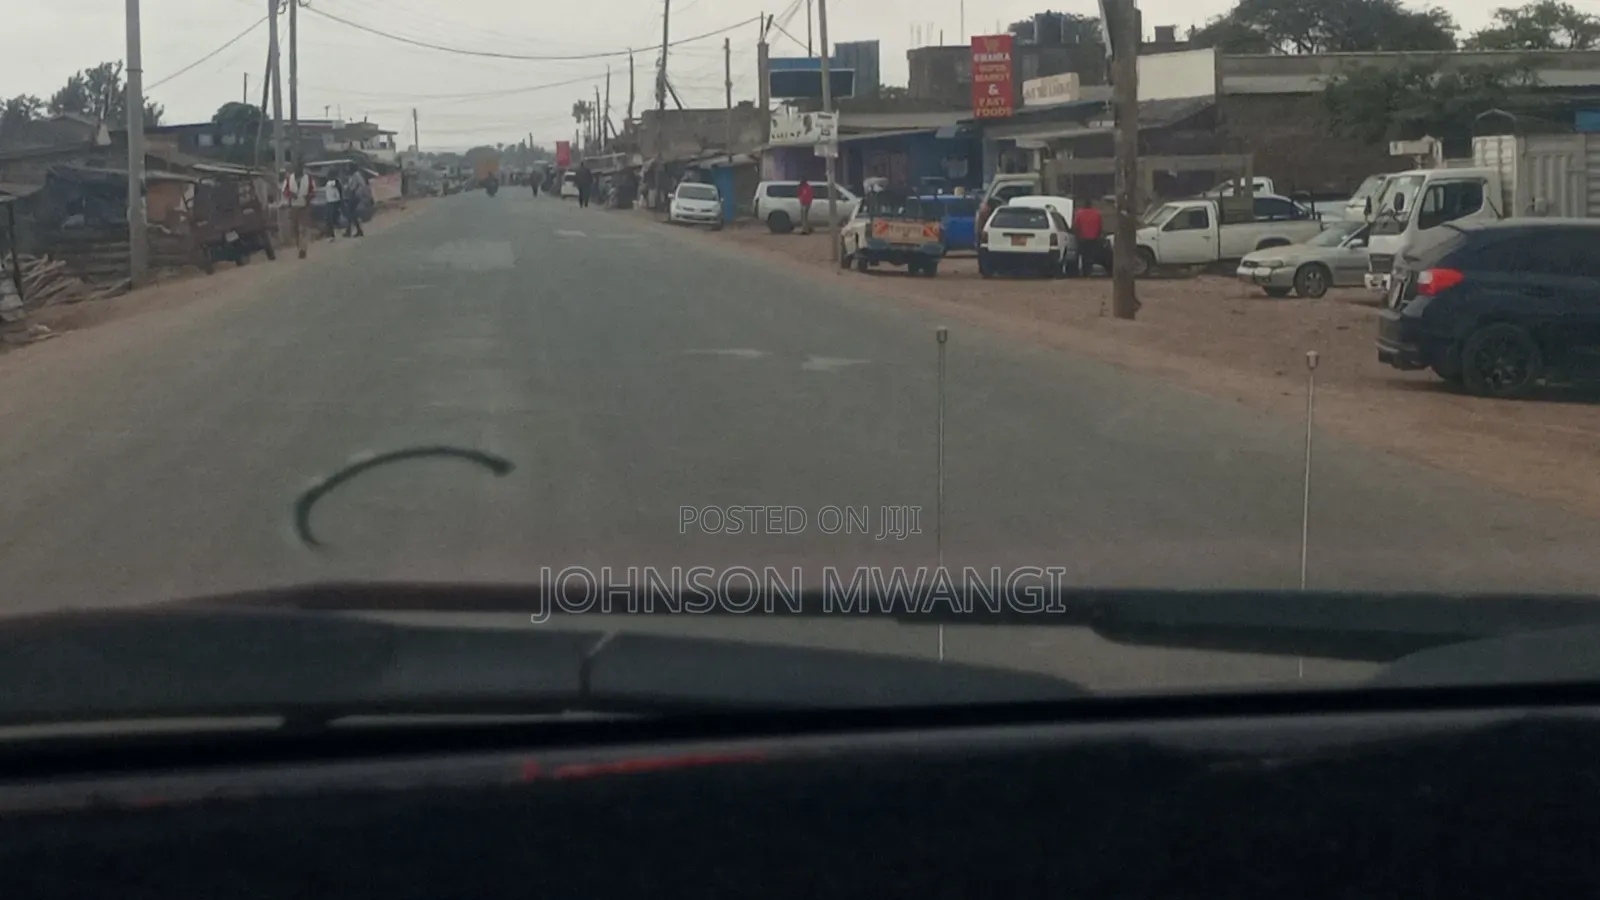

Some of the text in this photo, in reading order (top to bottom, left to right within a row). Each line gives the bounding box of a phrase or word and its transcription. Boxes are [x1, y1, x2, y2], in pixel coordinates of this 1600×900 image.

[987, 83, 1000, 95] &
[979, 97, 1006, 107] FAST
[976, 106, 1012, 117] FOODS
